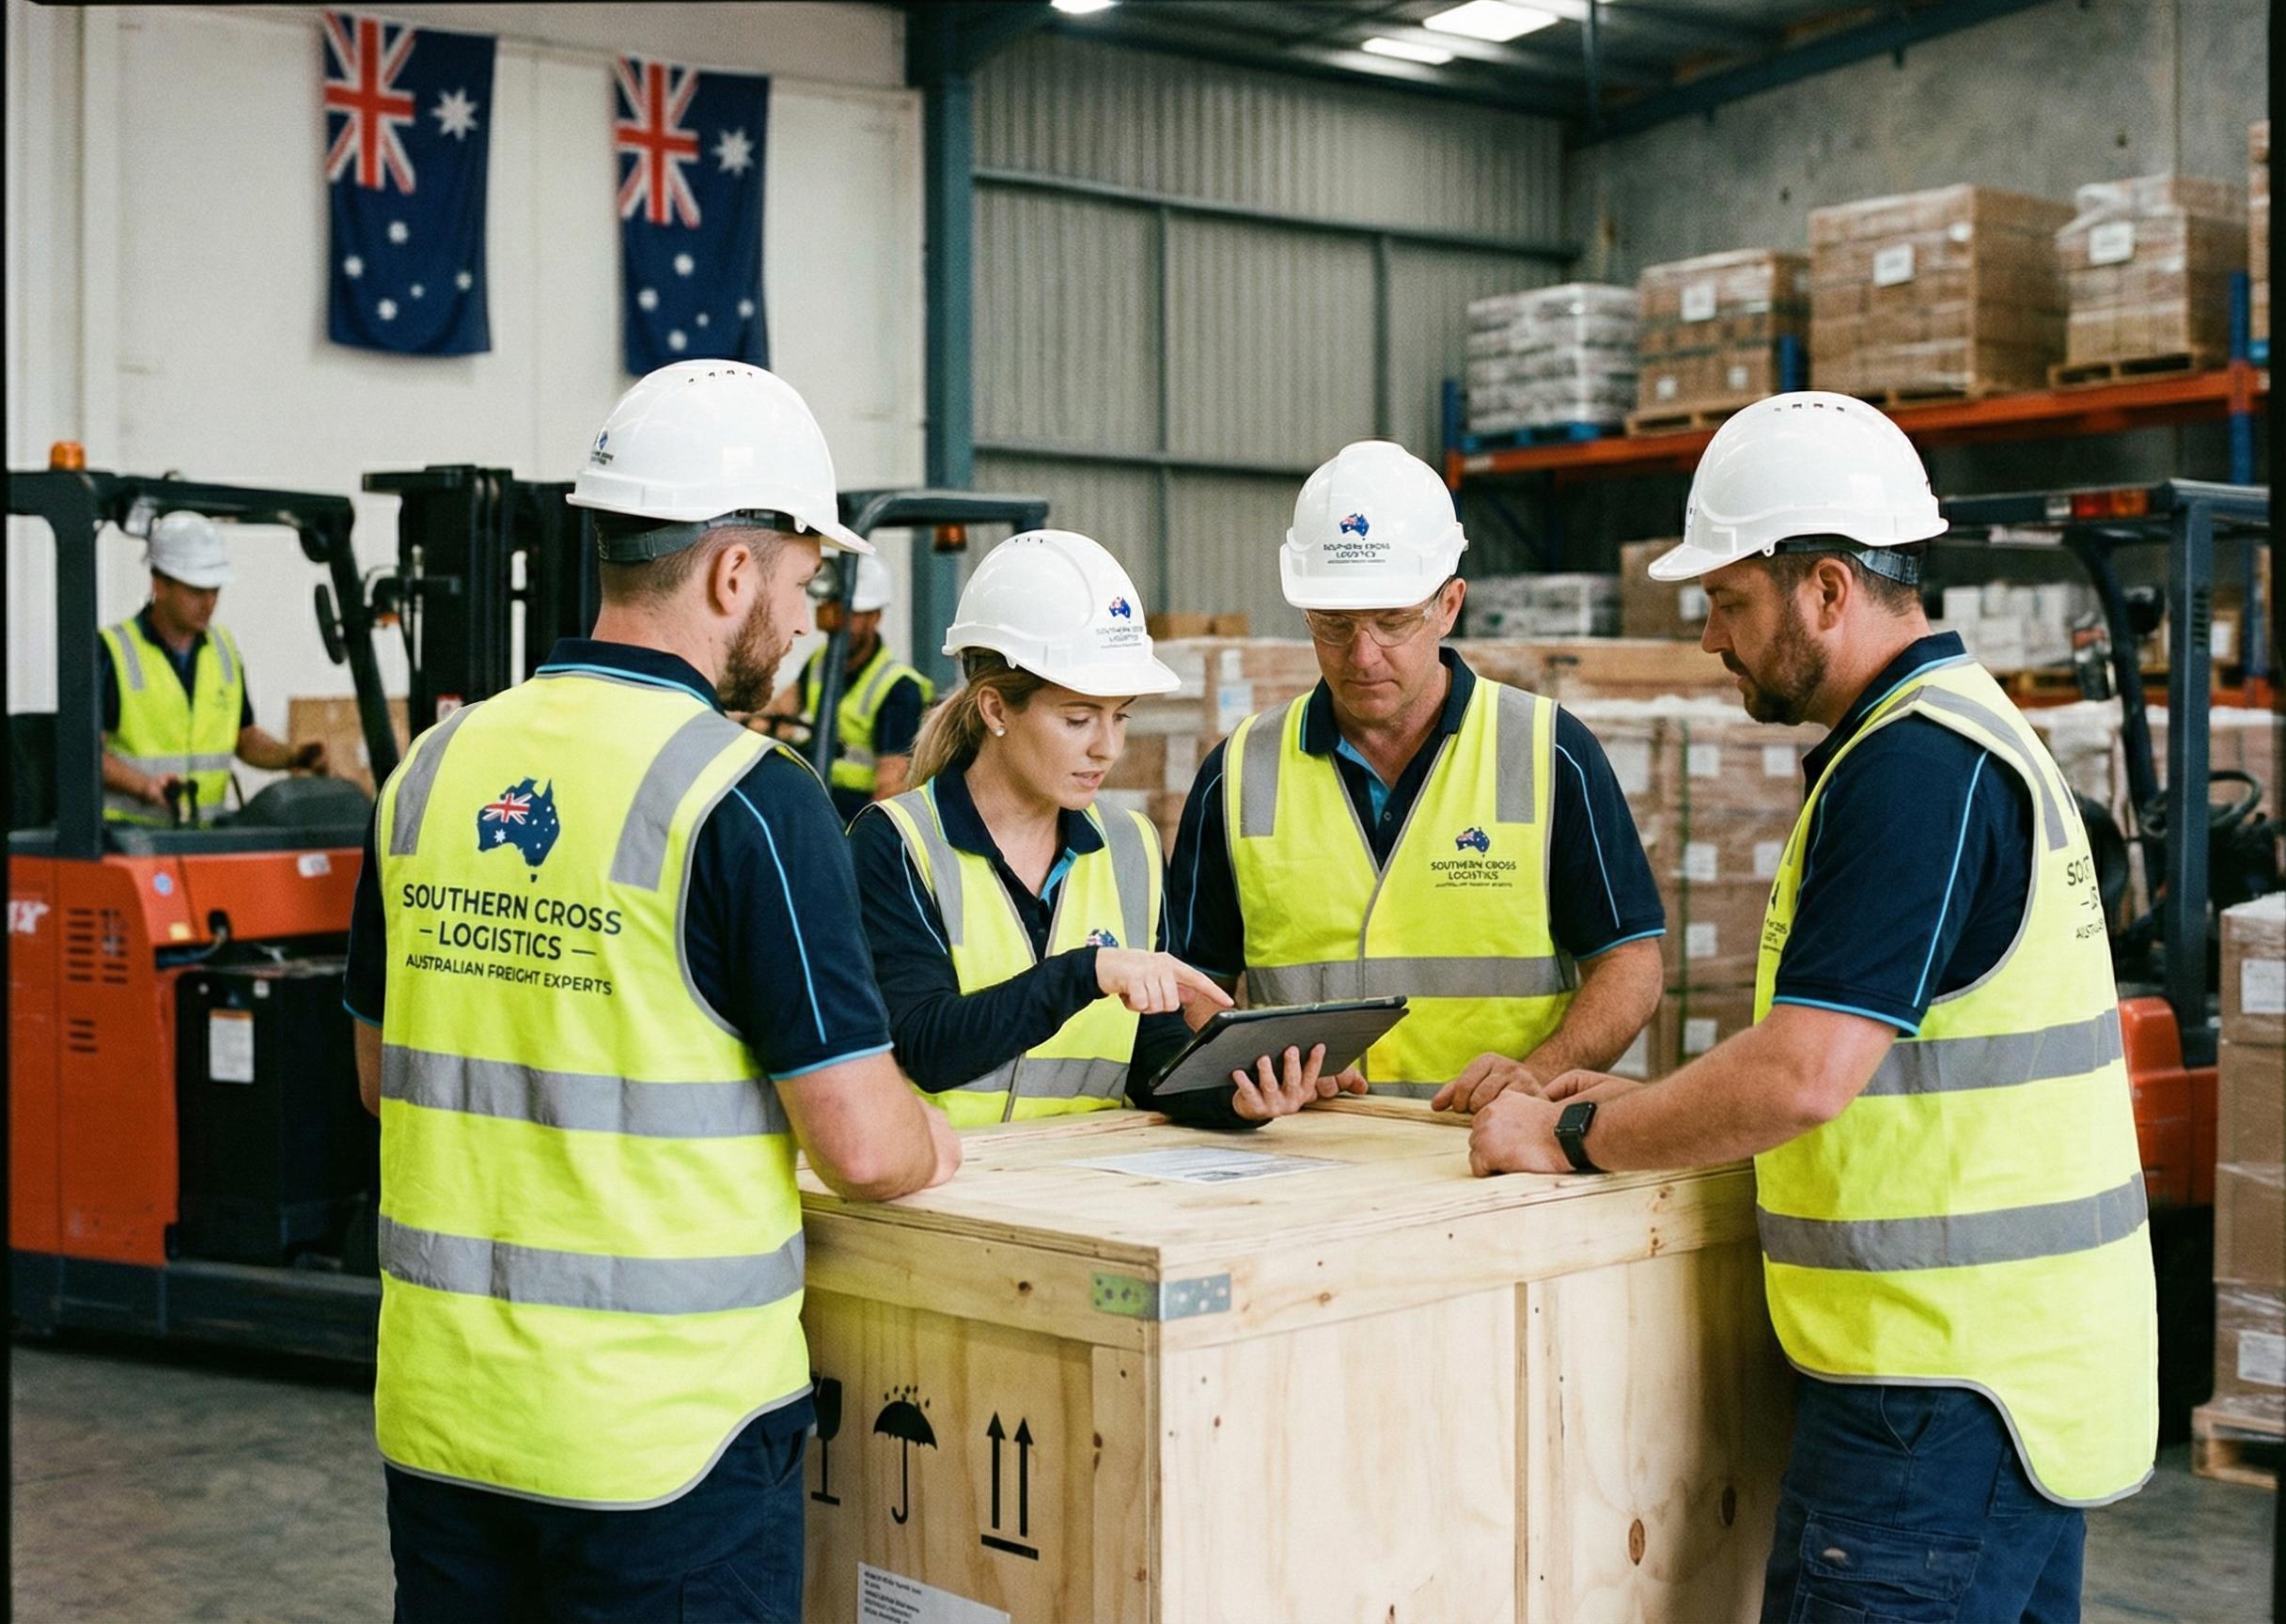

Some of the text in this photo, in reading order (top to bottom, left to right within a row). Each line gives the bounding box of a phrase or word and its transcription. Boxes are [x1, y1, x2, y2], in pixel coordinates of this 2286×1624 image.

[402, 883, 622, 935] SOUTHERN CROSS
[439, 921, 561, 960] LOGISTICS
[406, 954, 613, 996] AUSTRALIAN FREIGHT EXPERTS
